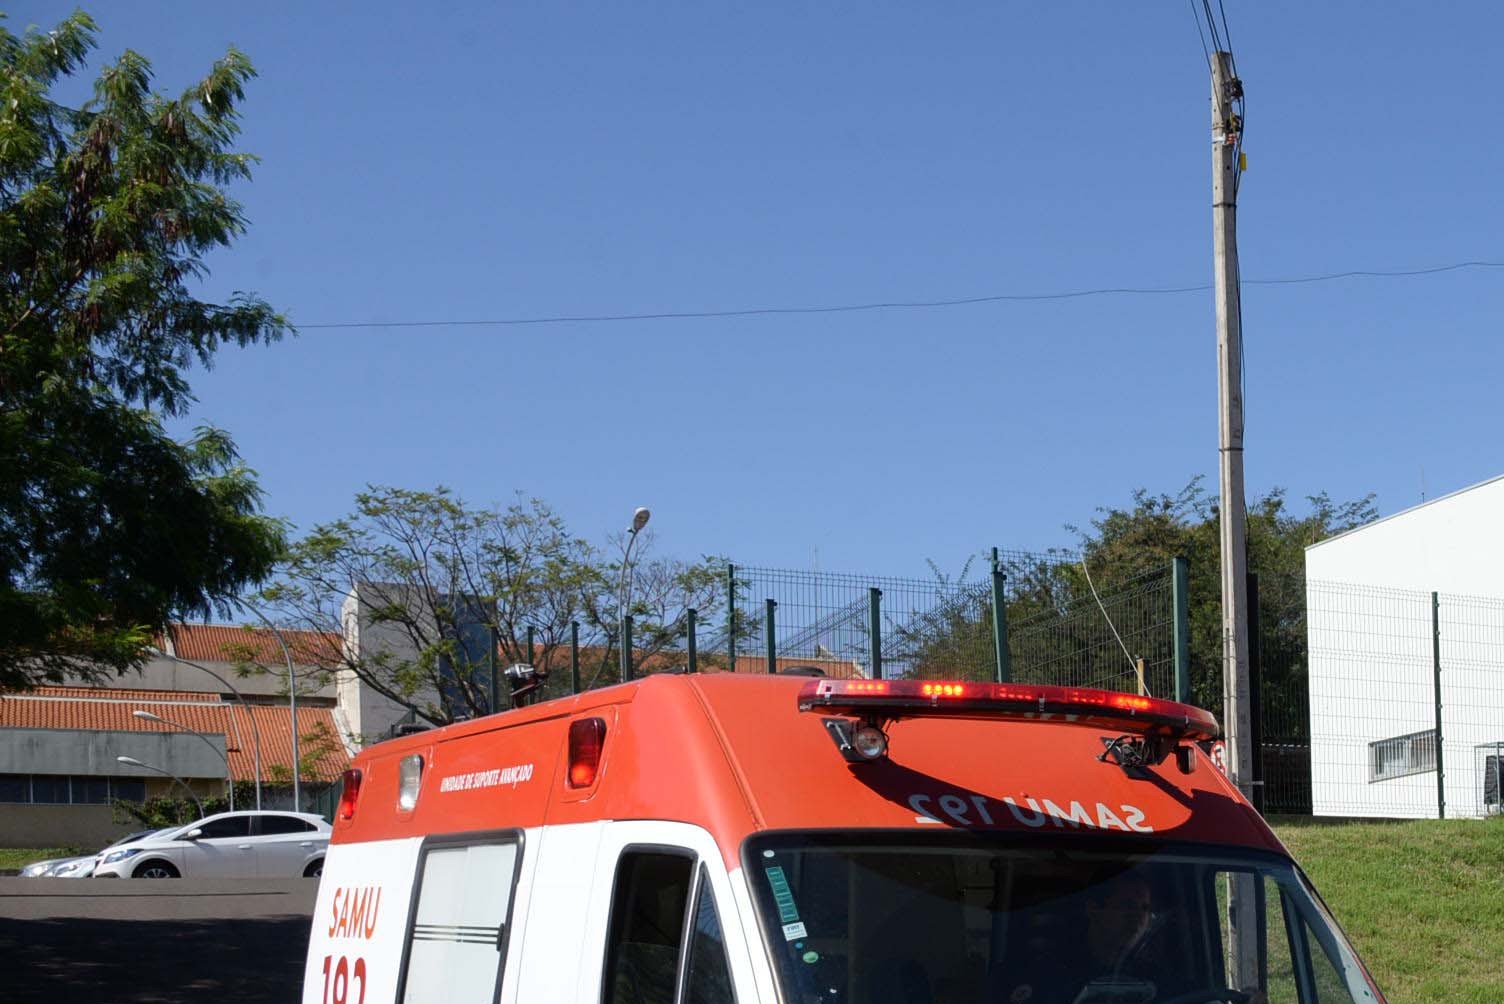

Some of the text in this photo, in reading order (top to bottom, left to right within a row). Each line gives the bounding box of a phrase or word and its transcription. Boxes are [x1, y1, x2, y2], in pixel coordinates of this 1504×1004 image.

[473, 769, 500, 788] SUPORTE
[499, 764, 534, 789] AVANÇADO
[328, 886, 382, 940] SAMU
